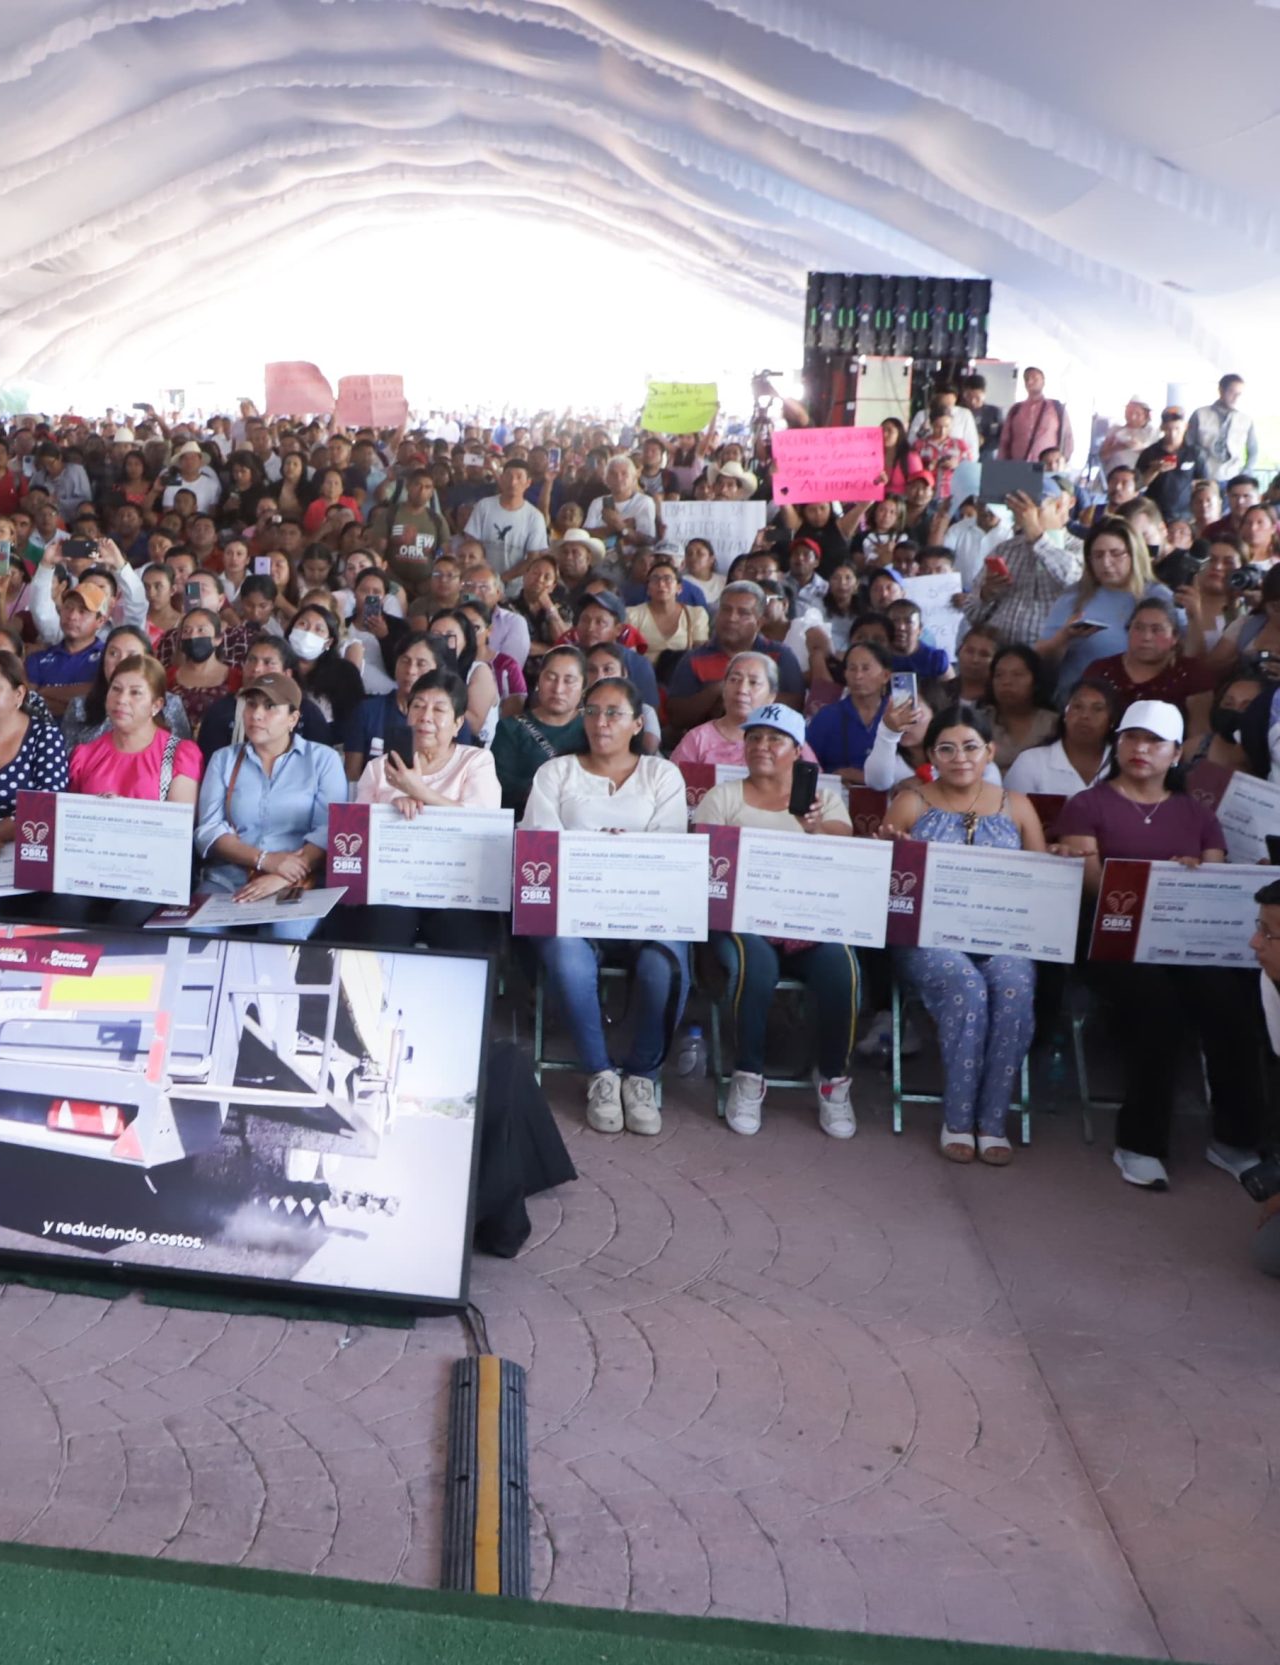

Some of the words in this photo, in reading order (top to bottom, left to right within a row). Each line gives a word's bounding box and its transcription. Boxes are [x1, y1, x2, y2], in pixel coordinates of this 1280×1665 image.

[21, 849, 48, 858] OBRA
[333, 861, 362, 870] OBRA
[521, 891, 550, 900] OBRA
[1102, 918, 1132, 927] OBRA
[51, 950, 86, 961] Pensar
[51, 959, 89, 969] Grande
[42, 1220, 54, 1235] y
[56, 1221, 146, 1242] reduciendo
[149, 1233, 205, 1249] costos.
